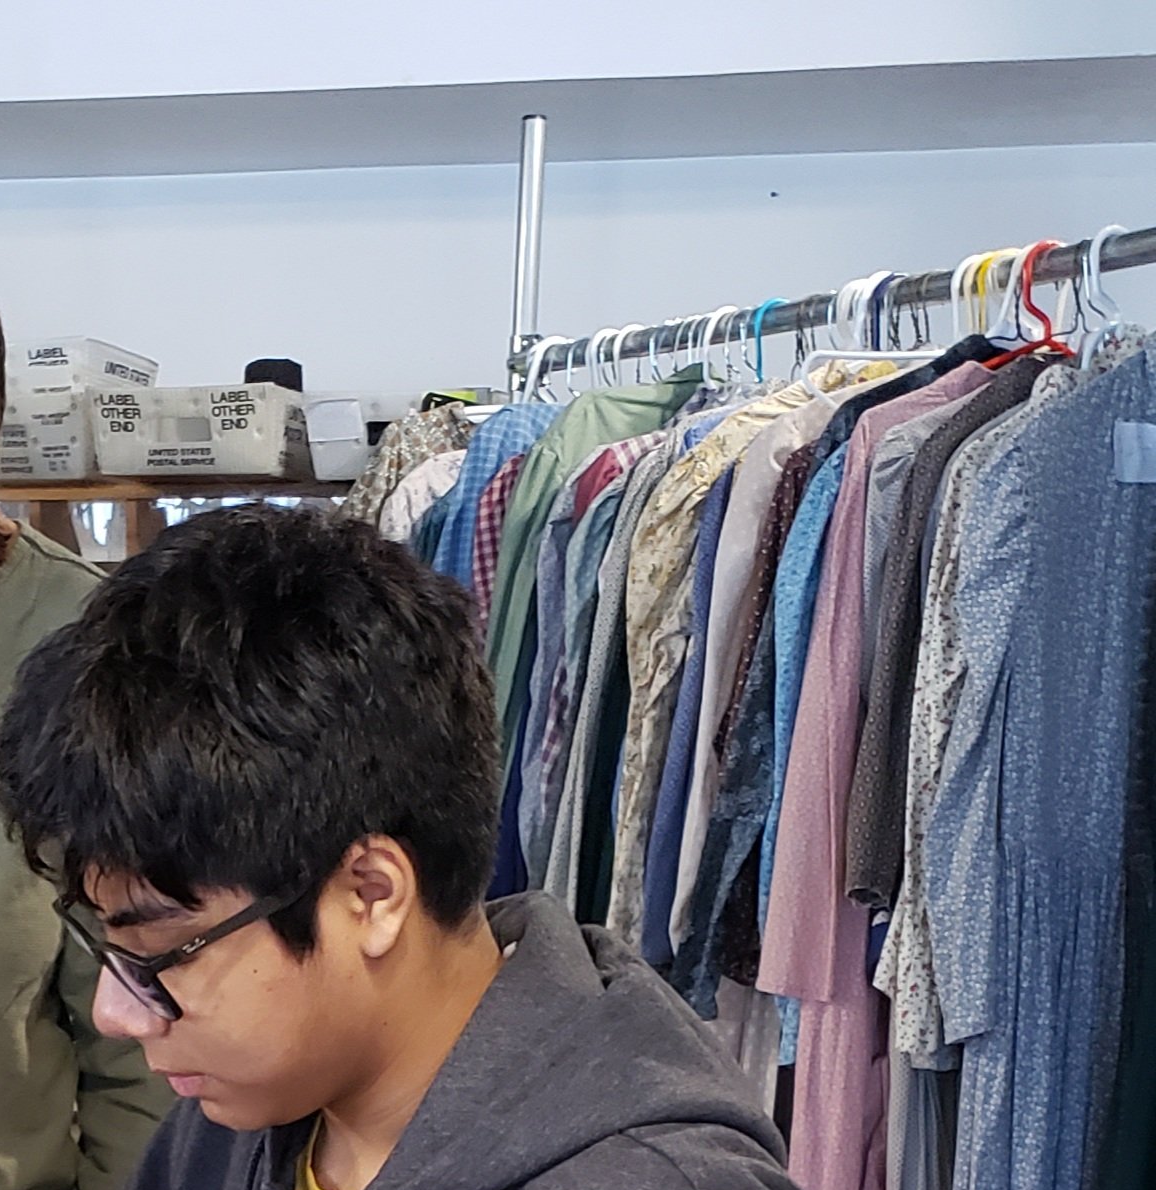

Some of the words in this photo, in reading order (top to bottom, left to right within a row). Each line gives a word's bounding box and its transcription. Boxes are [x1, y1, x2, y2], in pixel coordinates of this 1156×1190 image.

[28, 347, 67, 359] LABEL
[100, 394, 139, 405] LABEL
[210, 390, 254, 404] LABEL
[101, 408, 141, 419] OTHER
[211, 404, 255, 418] OTHER
[110, 421, 135, 432] END
[221, 417, 248, 430] END
[148, 448, 179, 456] UNITED
[180, 447, 211, 456] STATES
[147, 458, 179, 466] POSTAL
[180, 457, 216, 466] SERVICE
